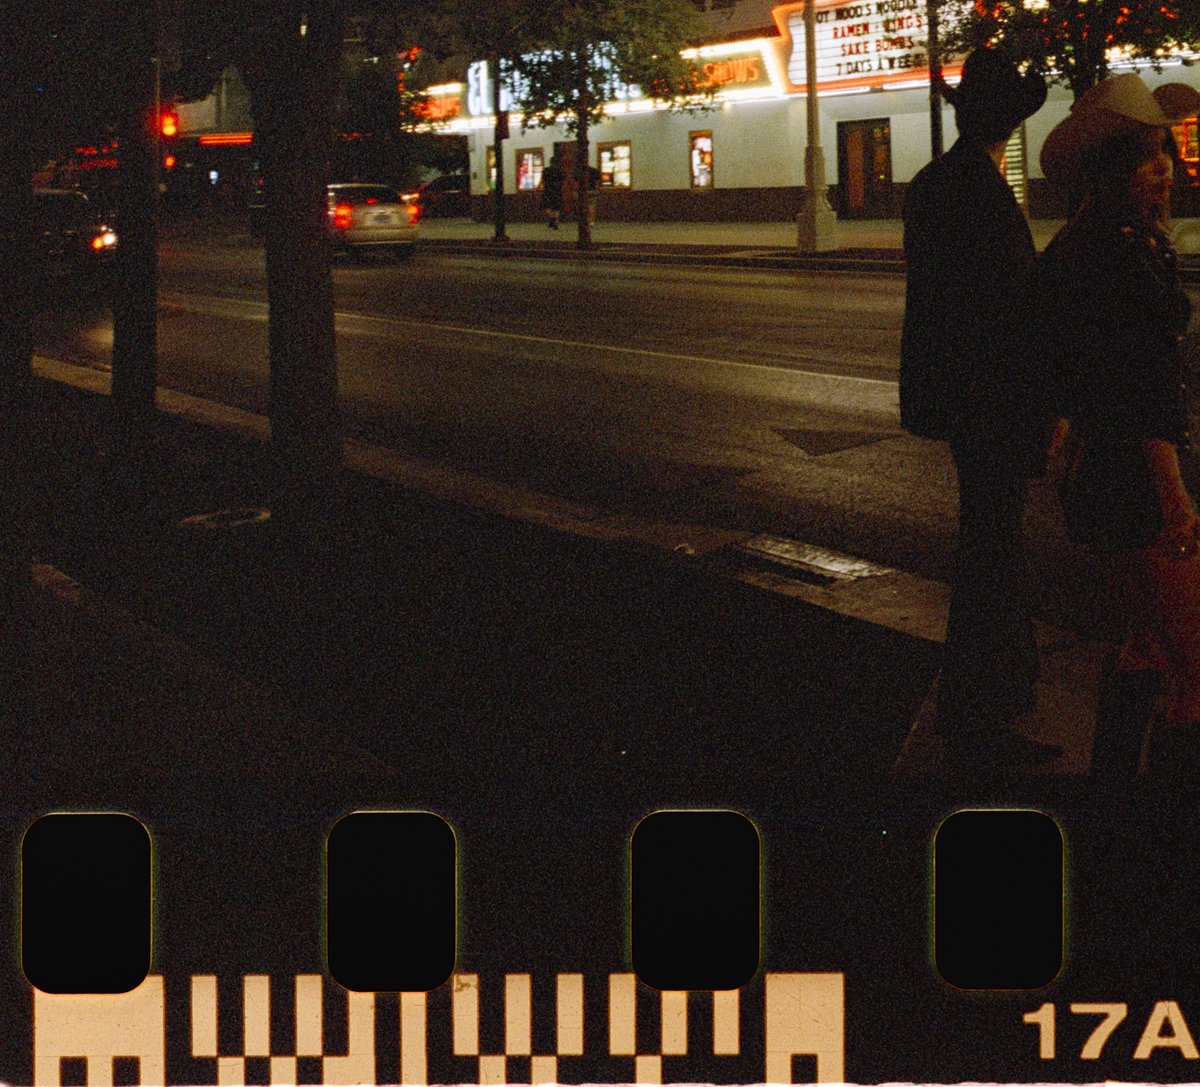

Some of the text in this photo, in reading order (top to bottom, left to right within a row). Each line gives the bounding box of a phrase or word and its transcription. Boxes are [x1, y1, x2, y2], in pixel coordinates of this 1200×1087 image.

[833, 22, 870, 39] RAMEN
[841, 40, 869, 57] SAKE
[847, 58, 873, 74] DAYS
[1023, 1000, 1200, 1060] 17A
